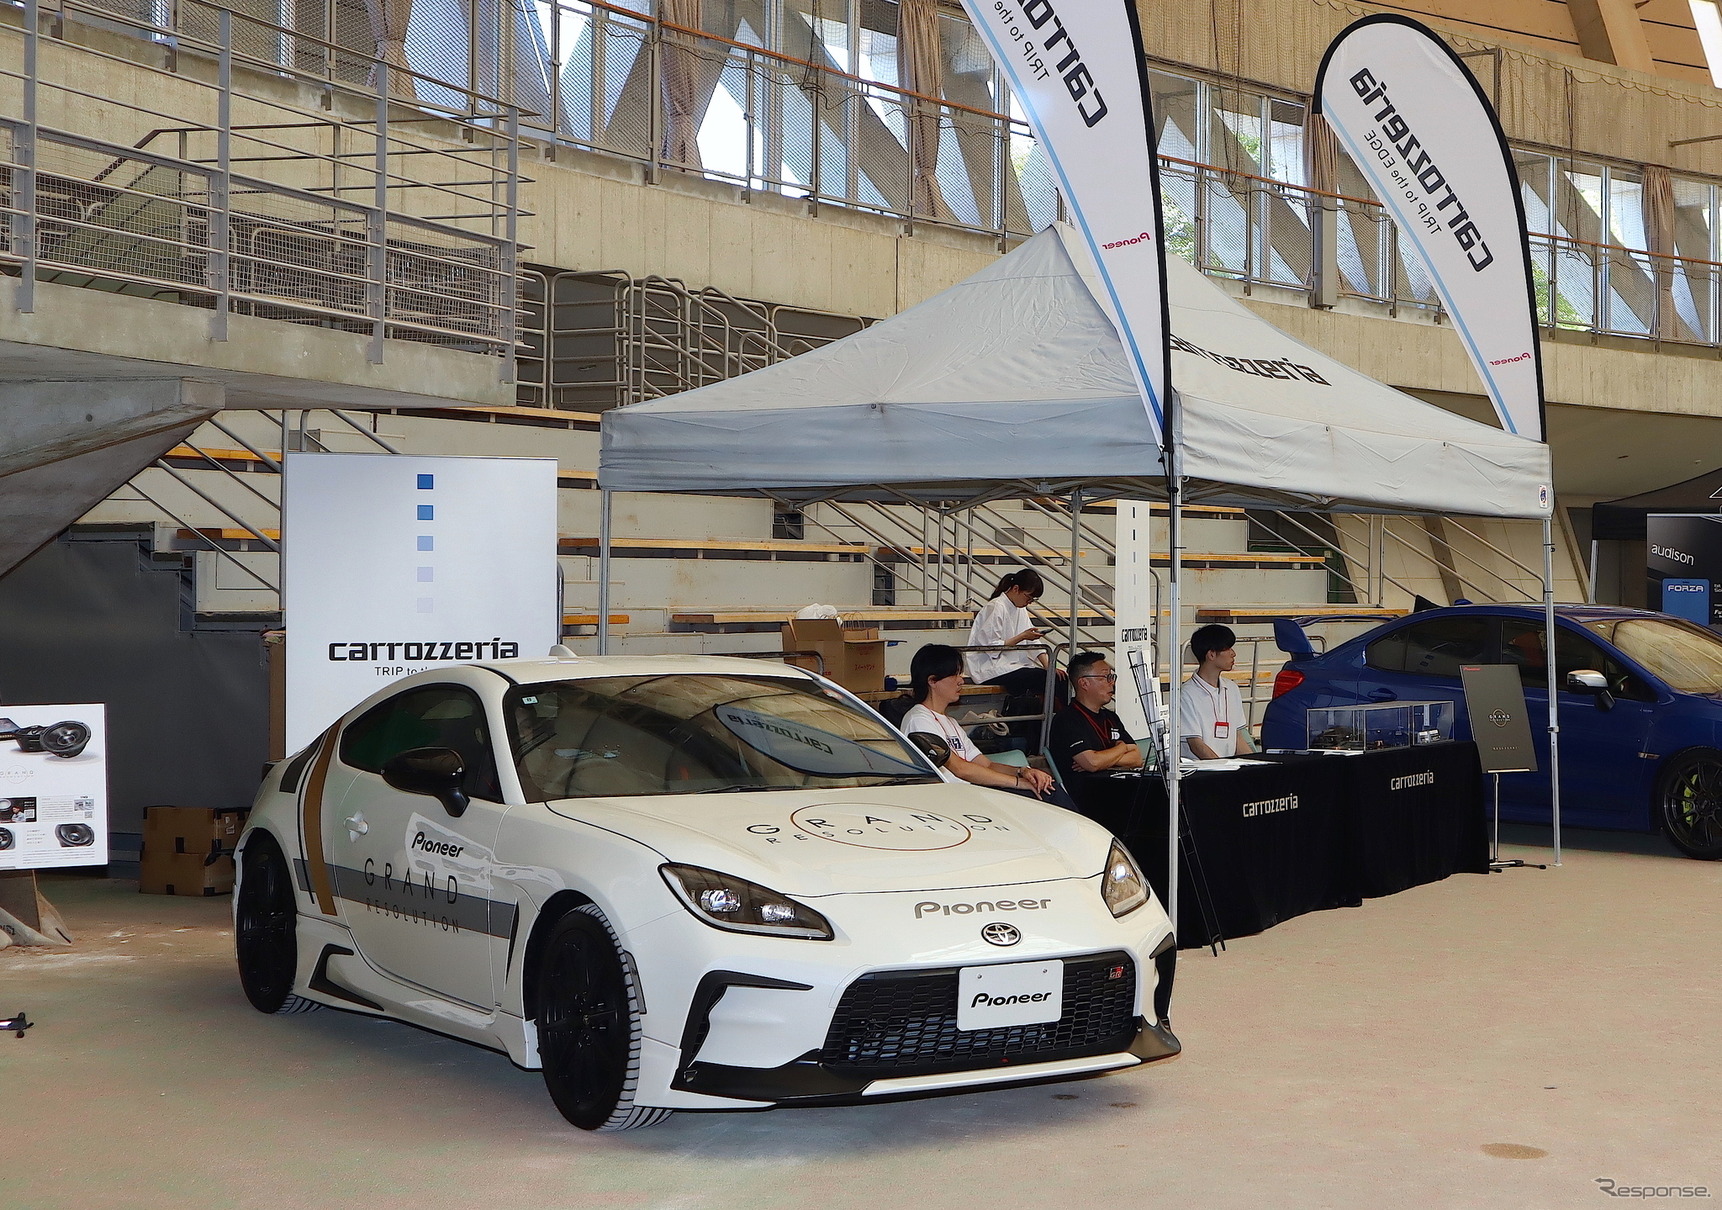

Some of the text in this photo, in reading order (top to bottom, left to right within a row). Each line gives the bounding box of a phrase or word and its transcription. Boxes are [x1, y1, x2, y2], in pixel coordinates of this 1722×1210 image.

[1651, 544, 1694, 566] audison
[374, 666, 404, 676] TRIP
[746, 813, 993, 835] GRAND
[766, 825, 1010, 845] RESOLUTION
[411, 831, 465, 858] Pioneer
[364, 857, 459, 905] GRAND
[365, 897, 460, 934] RESOLUTION
[914, 898, 1052, 920] Pioneer
[970, 991, 1053, 1008] Pioneer
